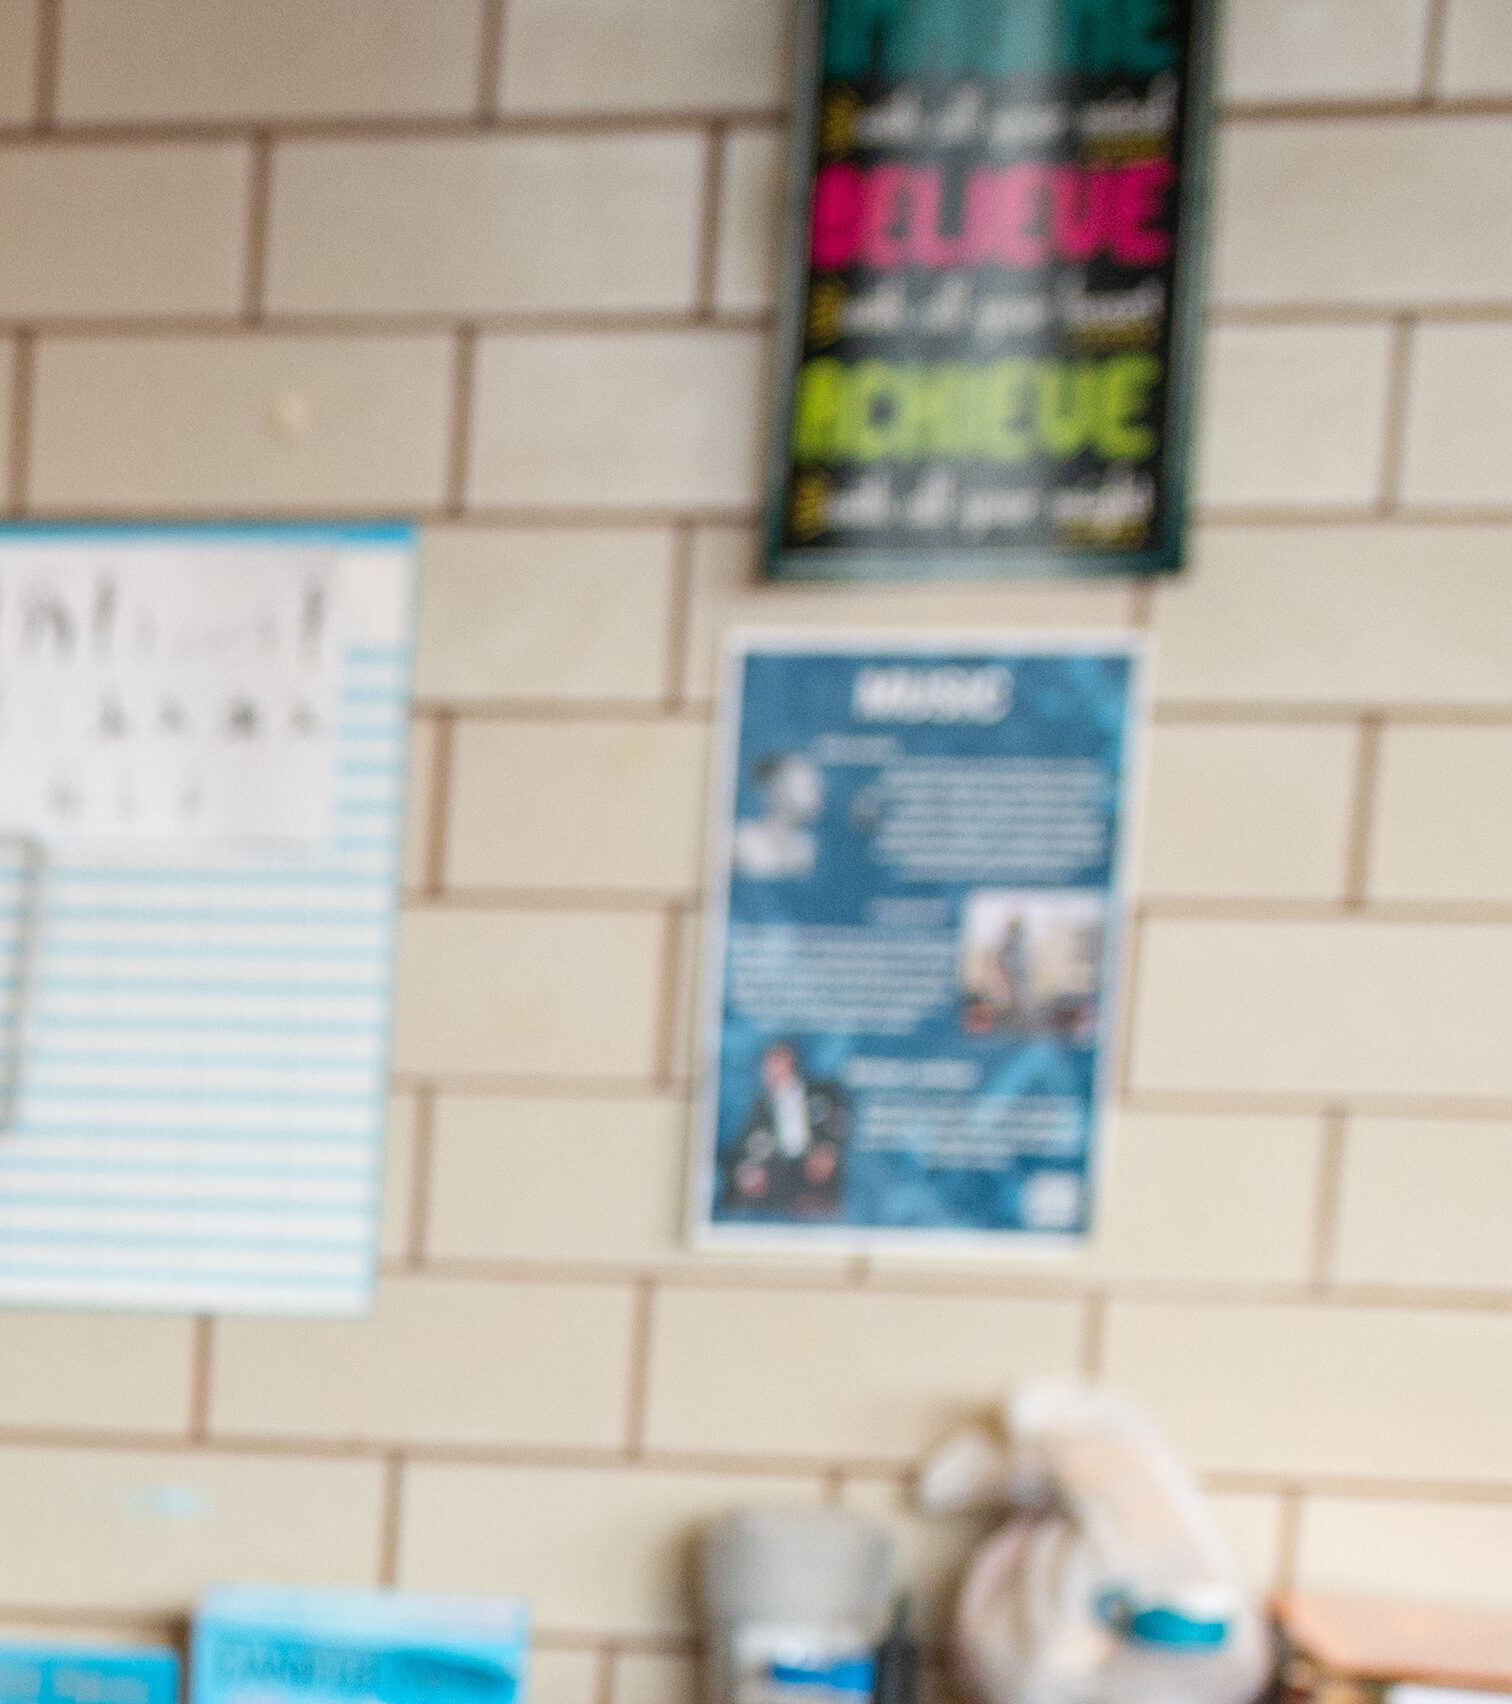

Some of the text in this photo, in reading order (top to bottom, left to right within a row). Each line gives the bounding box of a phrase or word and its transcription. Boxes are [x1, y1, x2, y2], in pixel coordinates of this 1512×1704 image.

[810, 157, 1178, 271] BELIEVE
[791, 354, 1162, 465] ACHIEVE
[851, 665, 1015, 725] MUSIC
